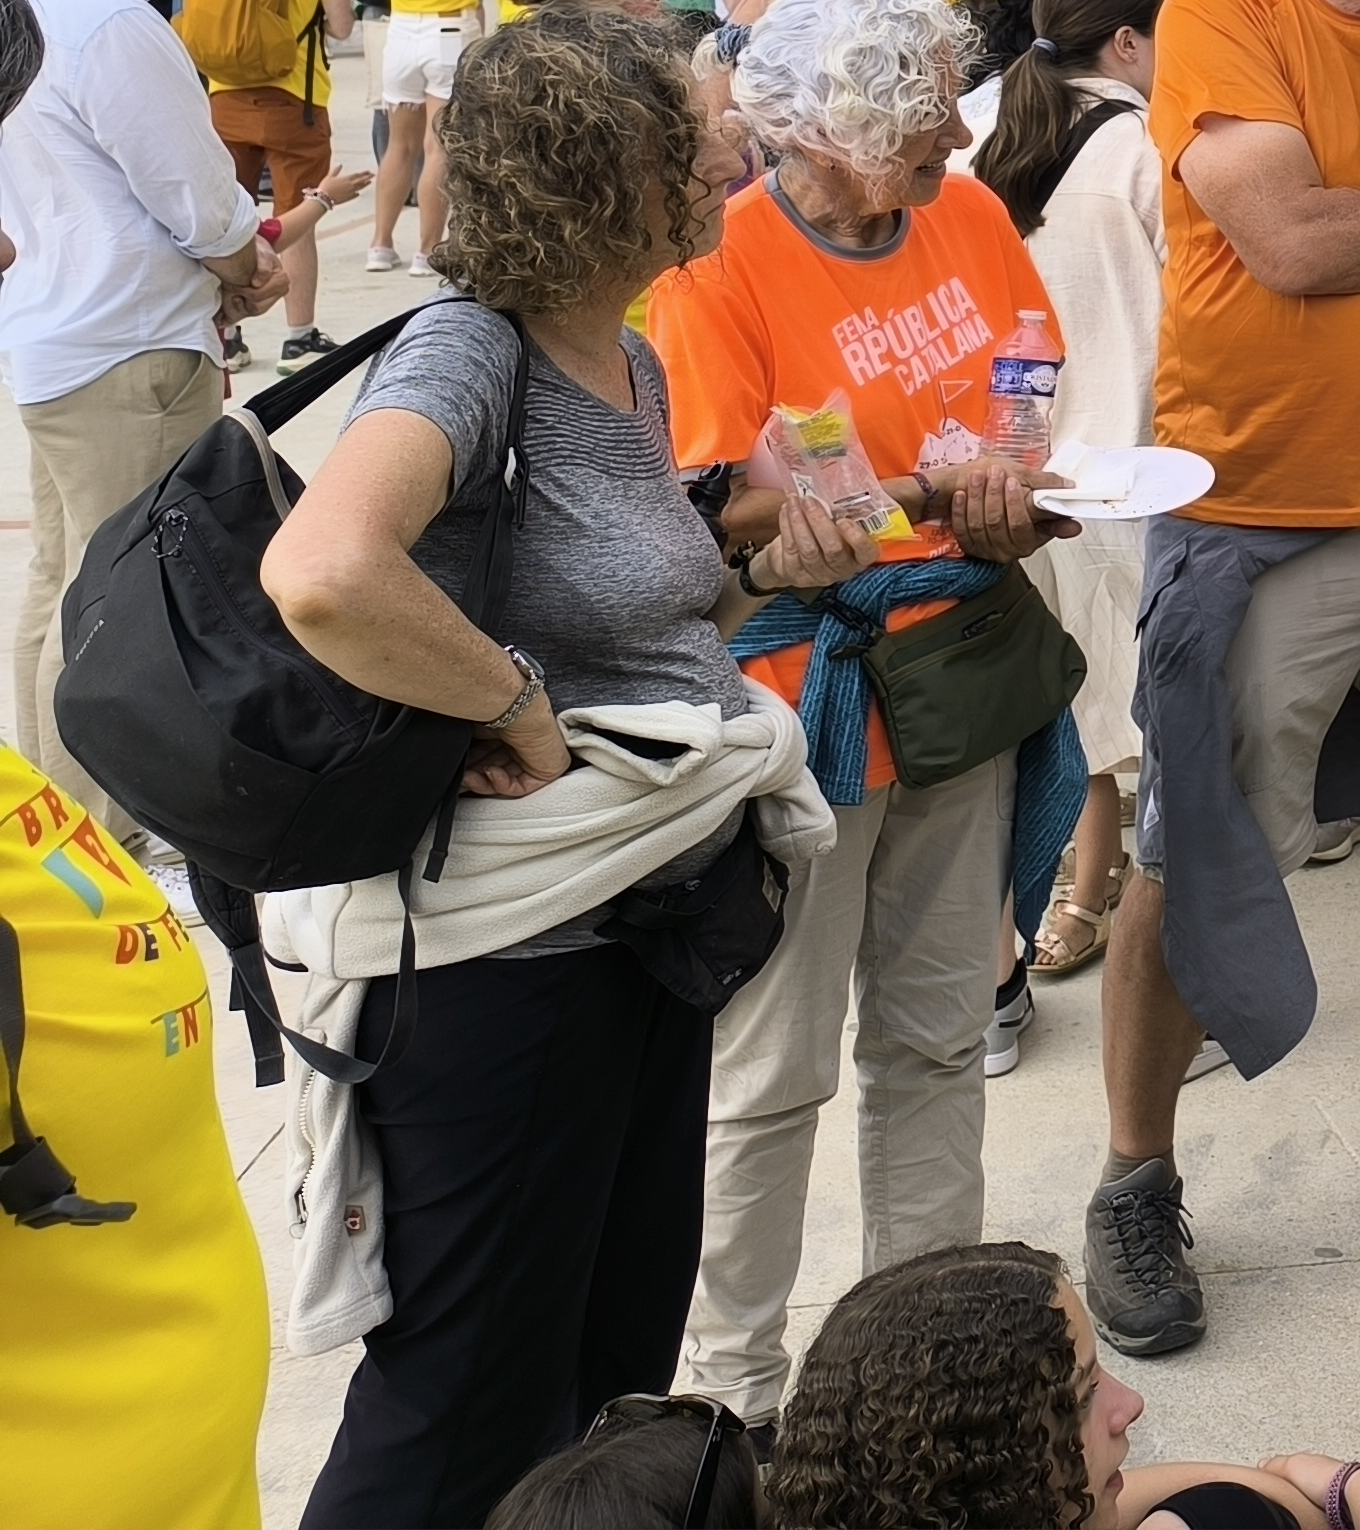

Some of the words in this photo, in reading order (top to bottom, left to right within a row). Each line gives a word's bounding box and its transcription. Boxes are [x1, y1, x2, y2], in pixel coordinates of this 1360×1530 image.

[893, 313, 995, 397] CATALANA
[16, 784, 76, 847] BR
[115, 922, 160, 965] DE
[162, 1004, 199, 1058] EN
